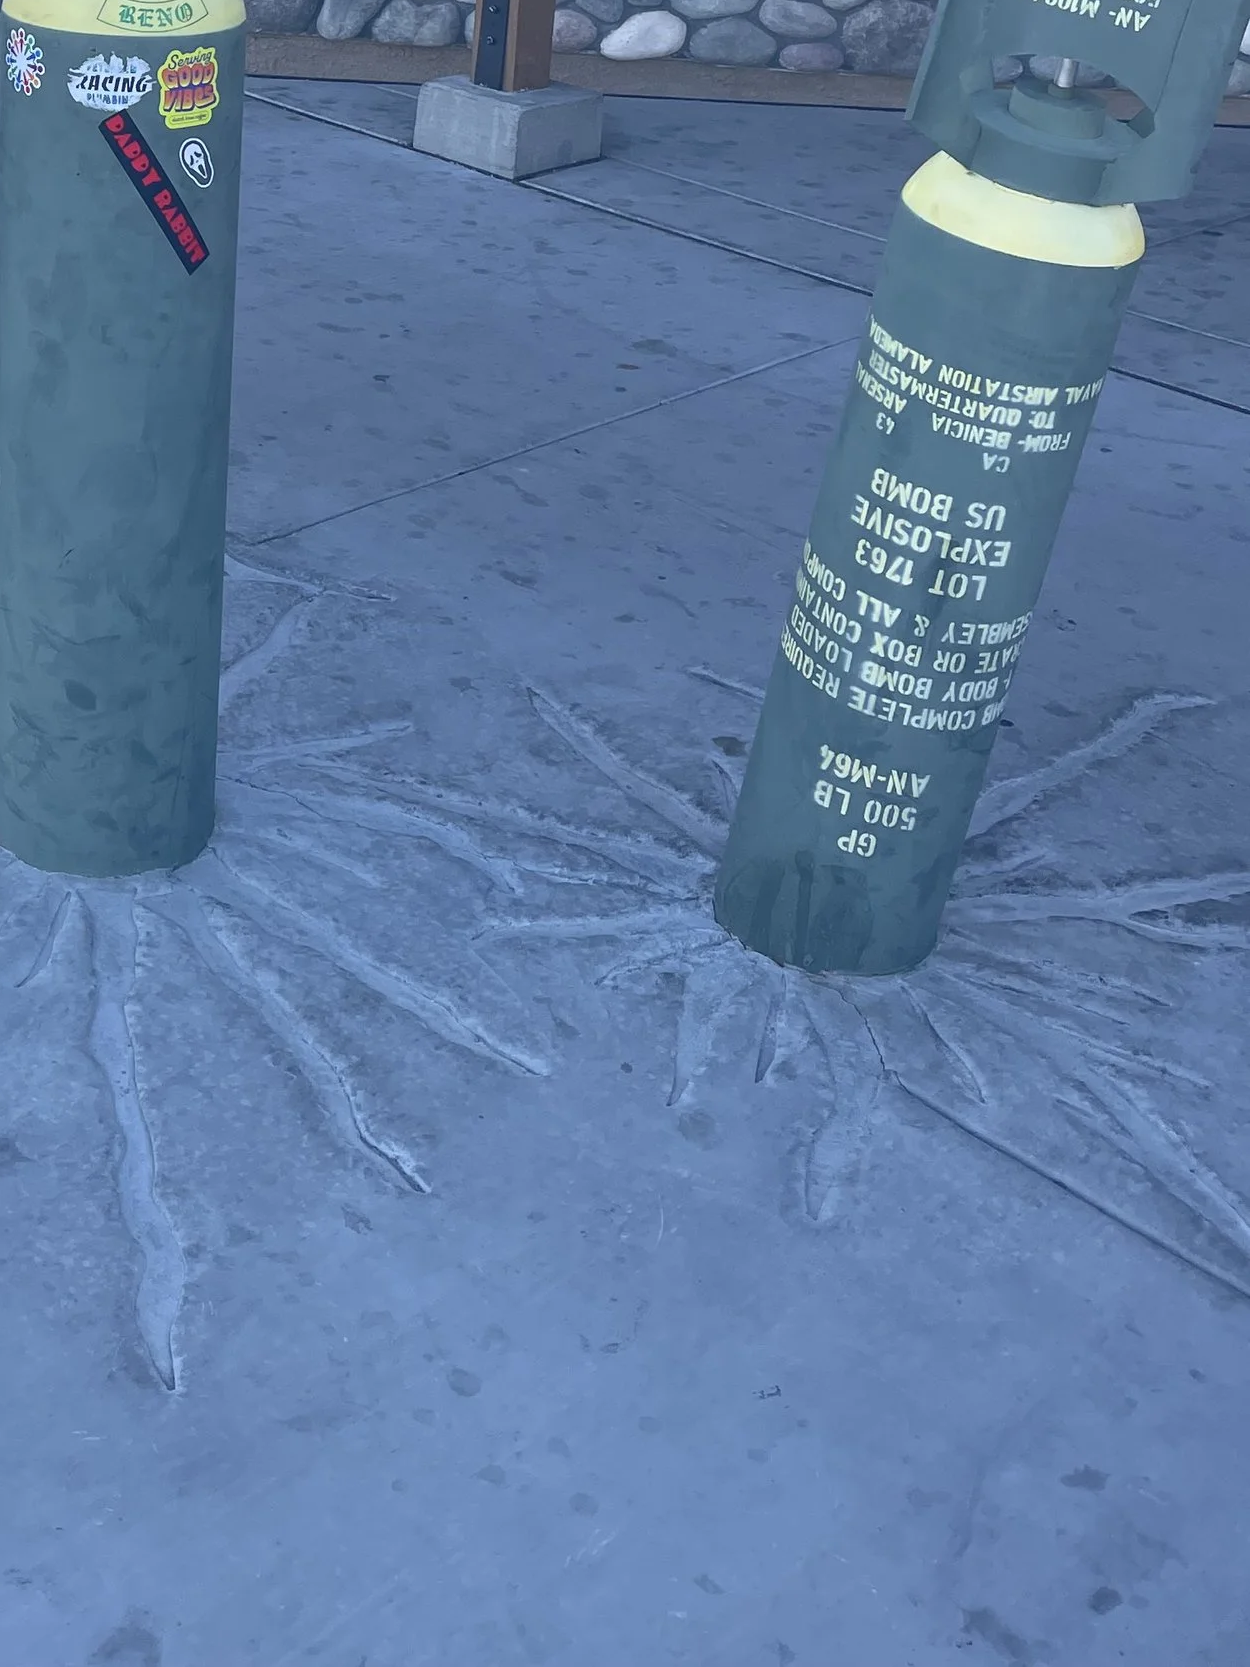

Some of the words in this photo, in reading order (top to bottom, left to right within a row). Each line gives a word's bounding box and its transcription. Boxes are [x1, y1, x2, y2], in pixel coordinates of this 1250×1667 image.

[162, 63, 215, 90] GOOD
[168, 51, 212, 70] Serving
[75, 74, 148, 93] RACING
[105, 113, 162, 187] DADDY
[153, 189, 205, 264] RABBIT
[868, 349, 1022, 428] QUARTERMASTER
[937, 364, 1059, 406] AIRSTATION
[875, 412, 895, 435] 43
[931, 412, 1012, 450] BENICIA
[1028, 411, 1056, 430] TO:
[982, 452, 1011, 473] CA
[870, 467, 953, 522] BOMB
[850, 494, 1012, 567] EXPLOSIVE
[964, 502, 1007, 532] US
[855, 538, 914, 586] 1763
[928, 569, 988, 601] LOT
[855, 589, 902, 628] ALL
[913, 614, 930, 637] &
[790, 603, 853, 673] LOADED
[869, 631, 923, 667] BOX
[932, 649, 967, 674] OR
[859, 660, 933, 700] BOMB
[941, 676, 999, 702] BODY
[847, 685, 977, 731] COMPLETE
[819, 744, 932, 799] AN-M64
[813, 779, 851, 816] LB
[863, 799, 918, 831] 500
[837, 829, 877, 858] GP
